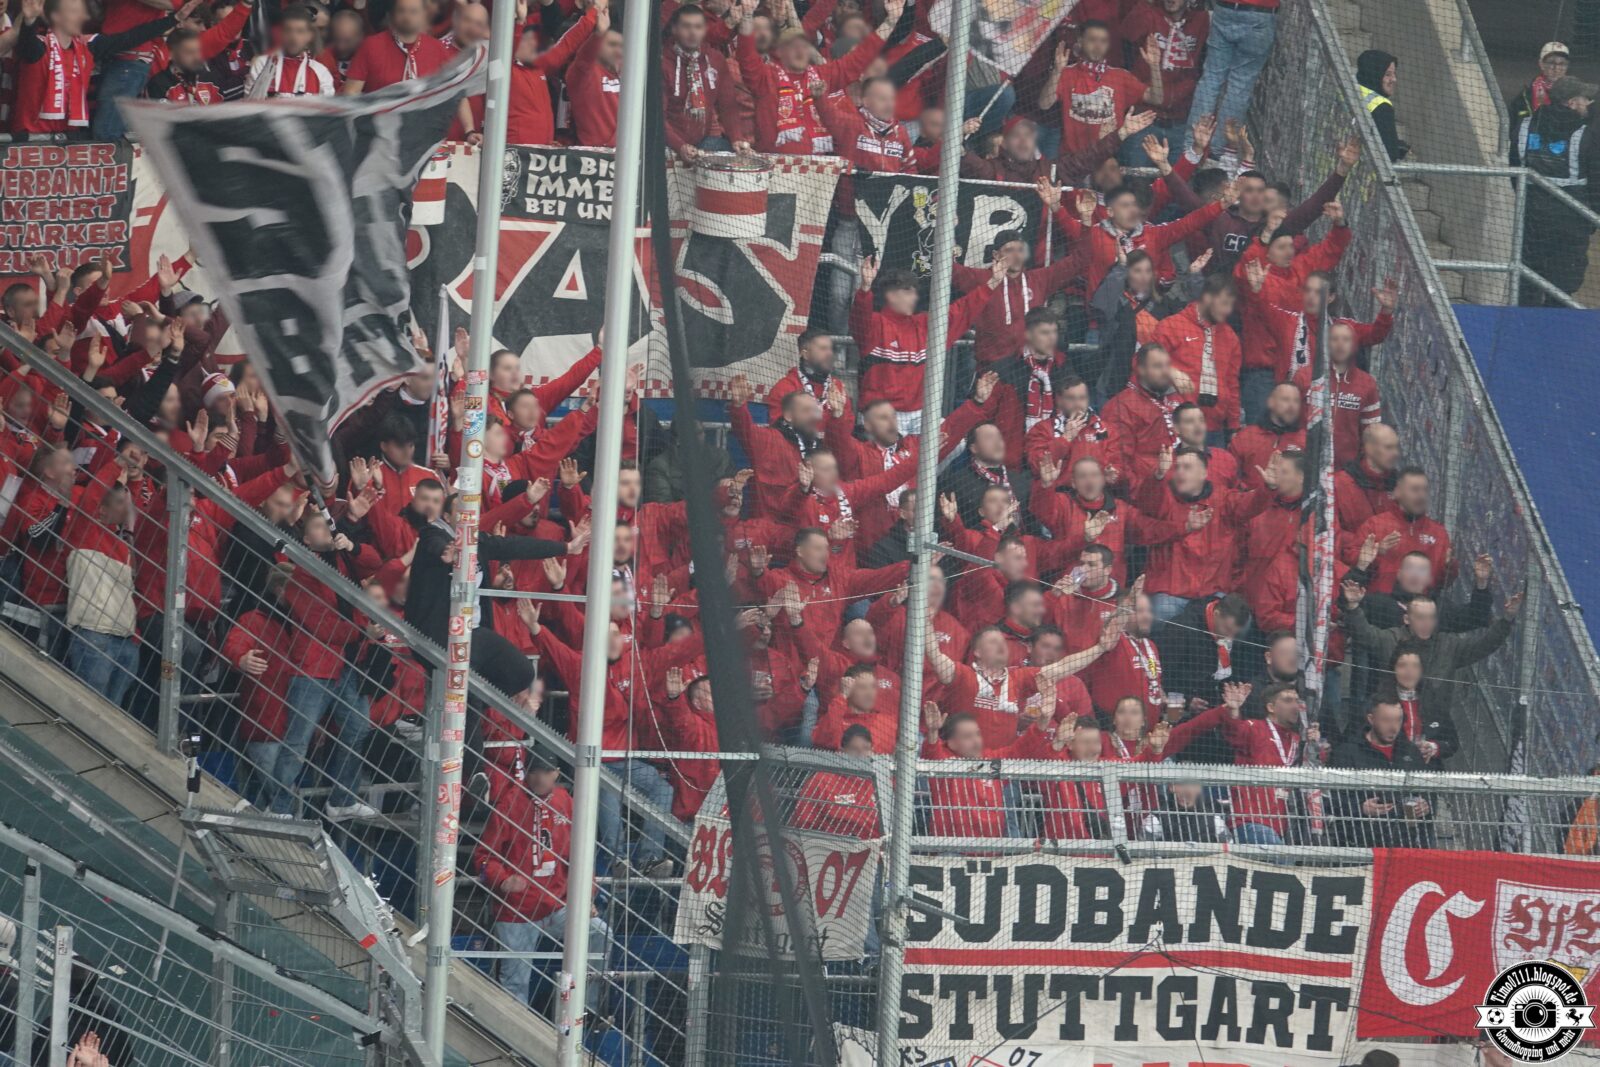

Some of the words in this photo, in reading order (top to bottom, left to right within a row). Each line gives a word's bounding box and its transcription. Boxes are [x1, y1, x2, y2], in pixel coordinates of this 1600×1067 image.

[3, 143, 116, 168] JEDER
[528, 153, 568, 174] DU
[580, 156, 616, 179] BIS
[526, 173, 615, 202] IMME
[2, 195, 117, 221] KEHRT
[525, 197, 567, 216] BEI
[577, 202, 613, 221] UN
[815, 847, 871, 919] 07
[906, 860, 1366, 954] SÜDBANDE
[898, 973, 1352, 1051] STUTTGART
